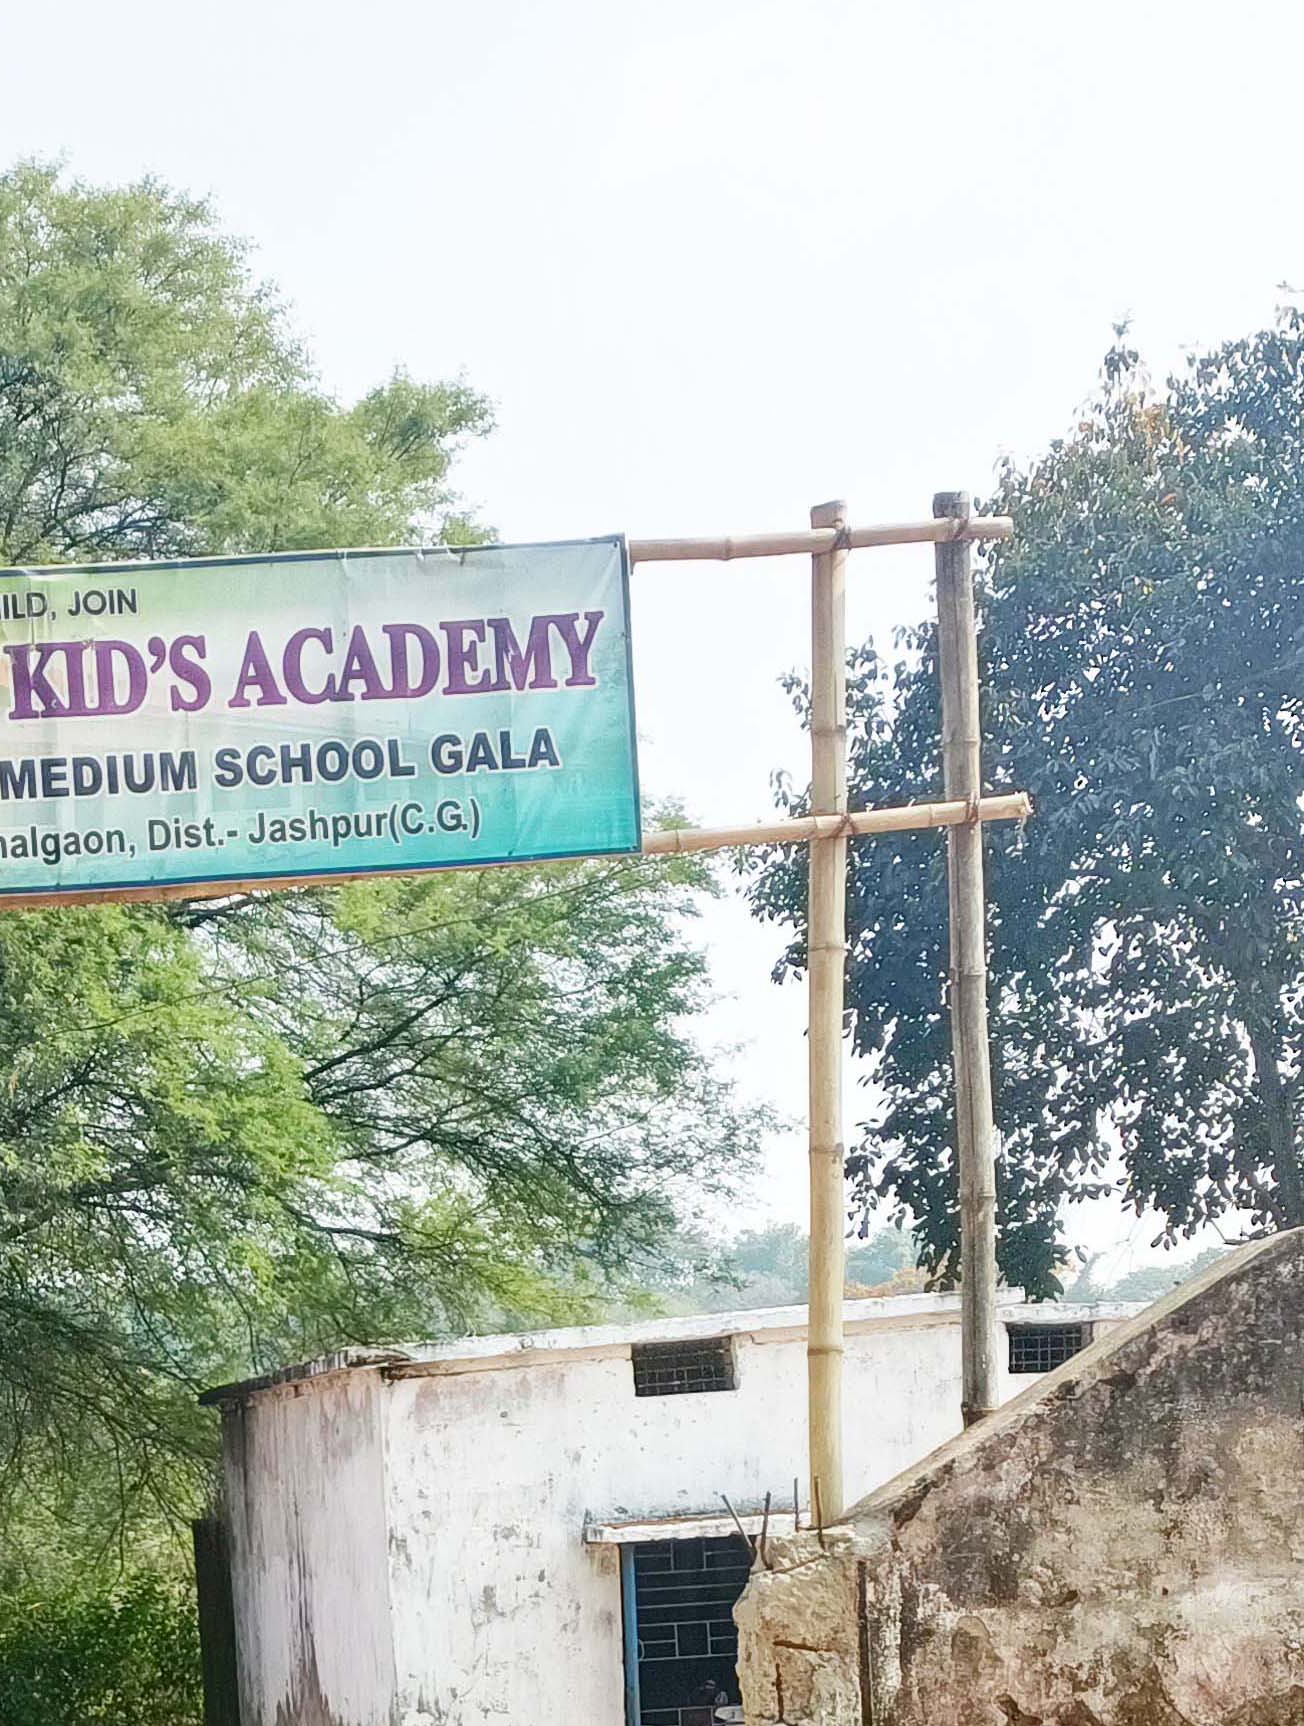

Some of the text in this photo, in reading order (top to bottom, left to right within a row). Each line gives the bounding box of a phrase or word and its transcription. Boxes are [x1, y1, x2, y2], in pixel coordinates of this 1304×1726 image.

[68, 588, 137, 617] JOIN
[228, 611, 604, 708] ACADEMY
[0, 751, 196, 799] MEDIUM
[215, 738, 414, 788] SCHOOL
[431, 727, 559, 774] GALA
[148, 817, 237, 851] Dist.-
